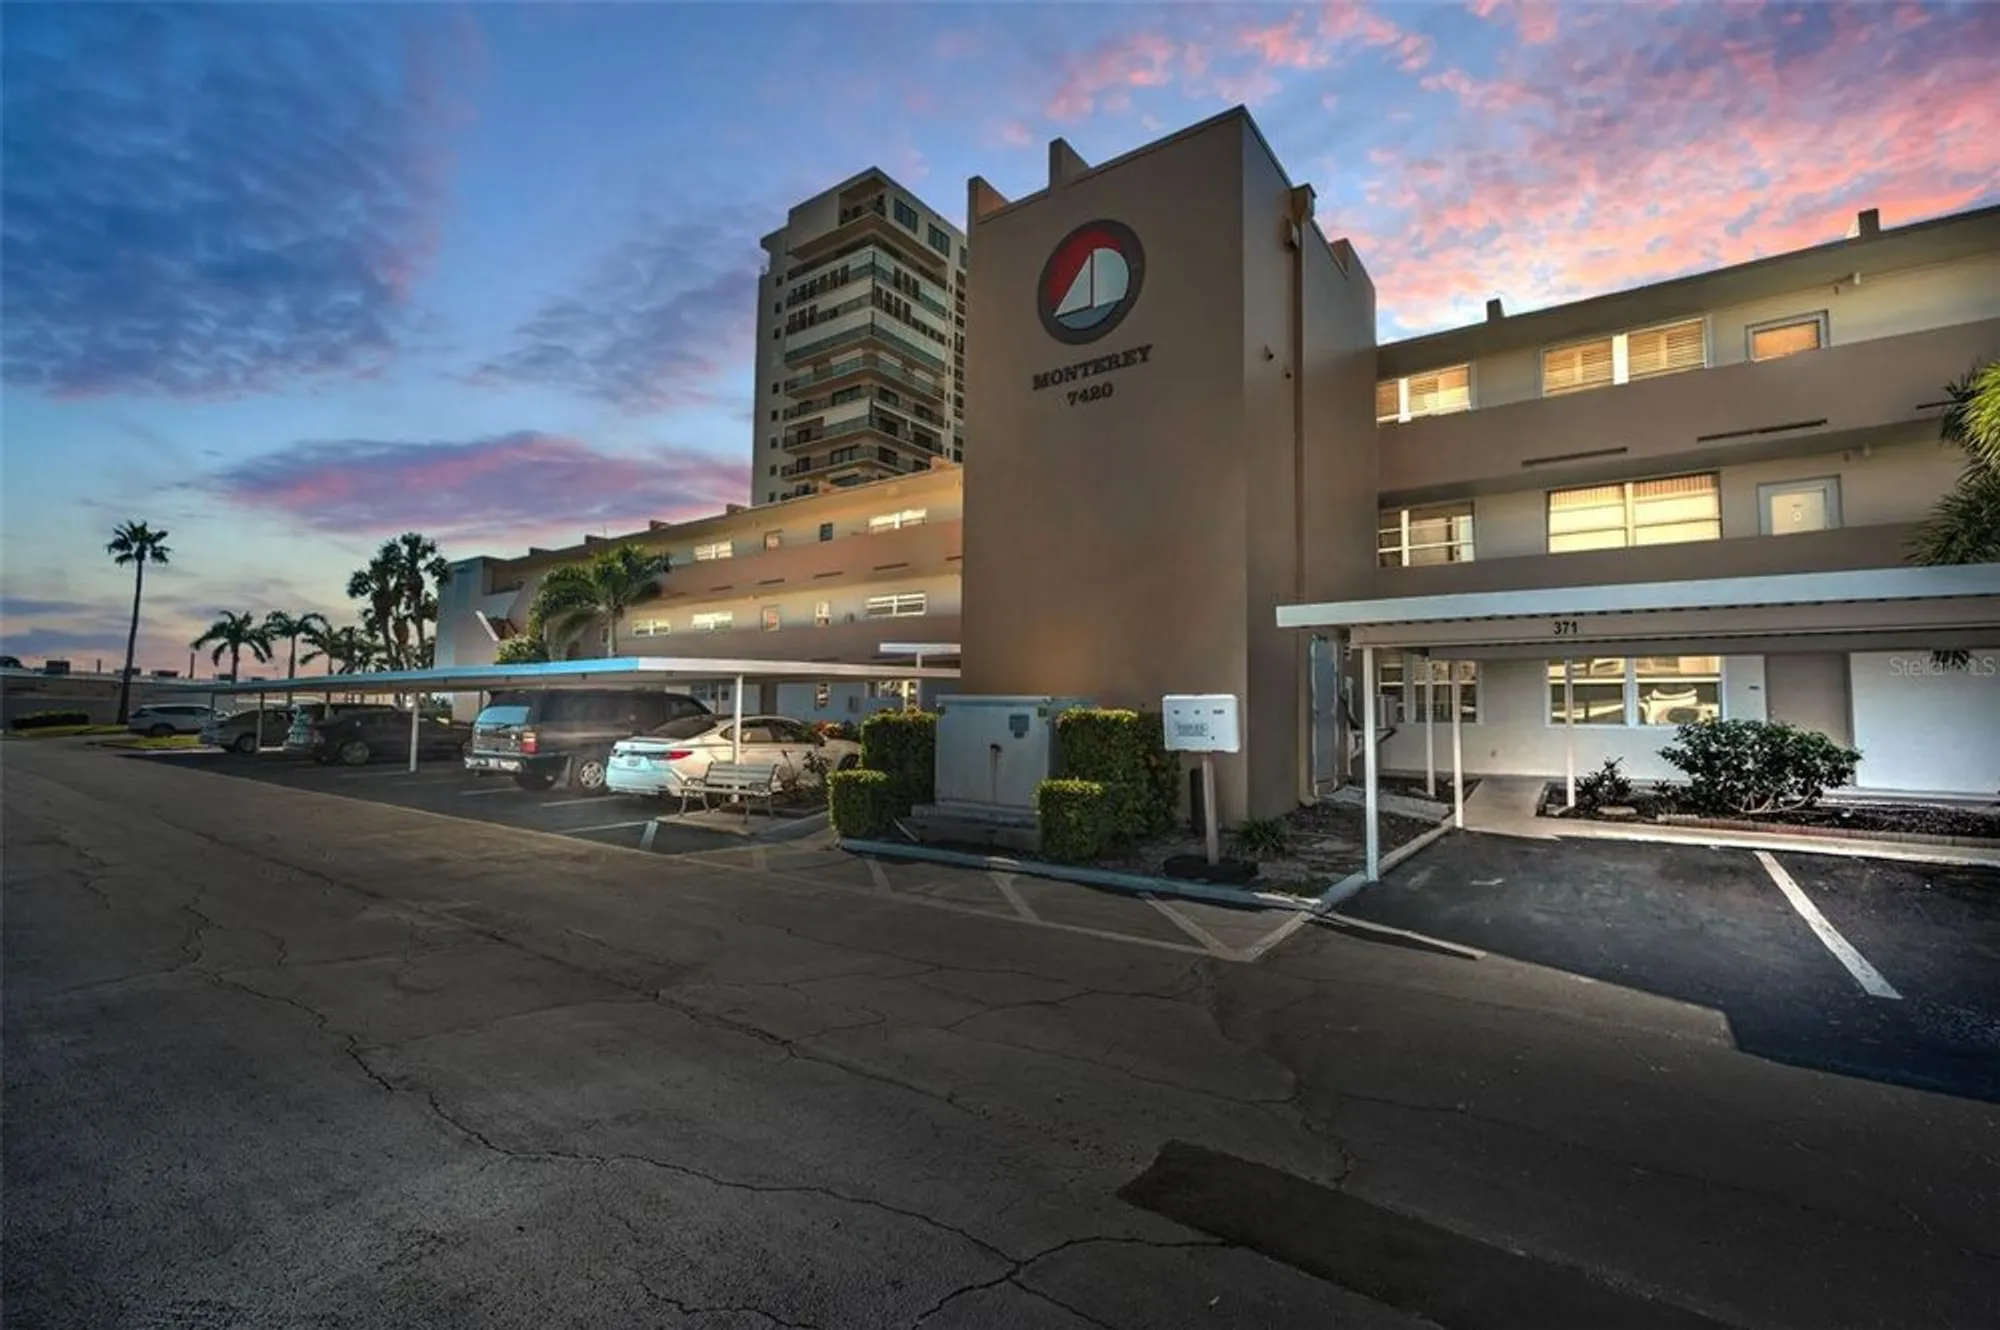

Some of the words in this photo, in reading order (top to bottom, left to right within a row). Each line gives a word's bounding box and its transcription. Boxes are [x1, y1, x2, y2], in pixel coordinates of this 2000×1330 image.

[1032, 344, 1153, 391] MONTEREY
[1067, 382, 1114, 406] 7420
[1554, 620, 1578, 635] 371
